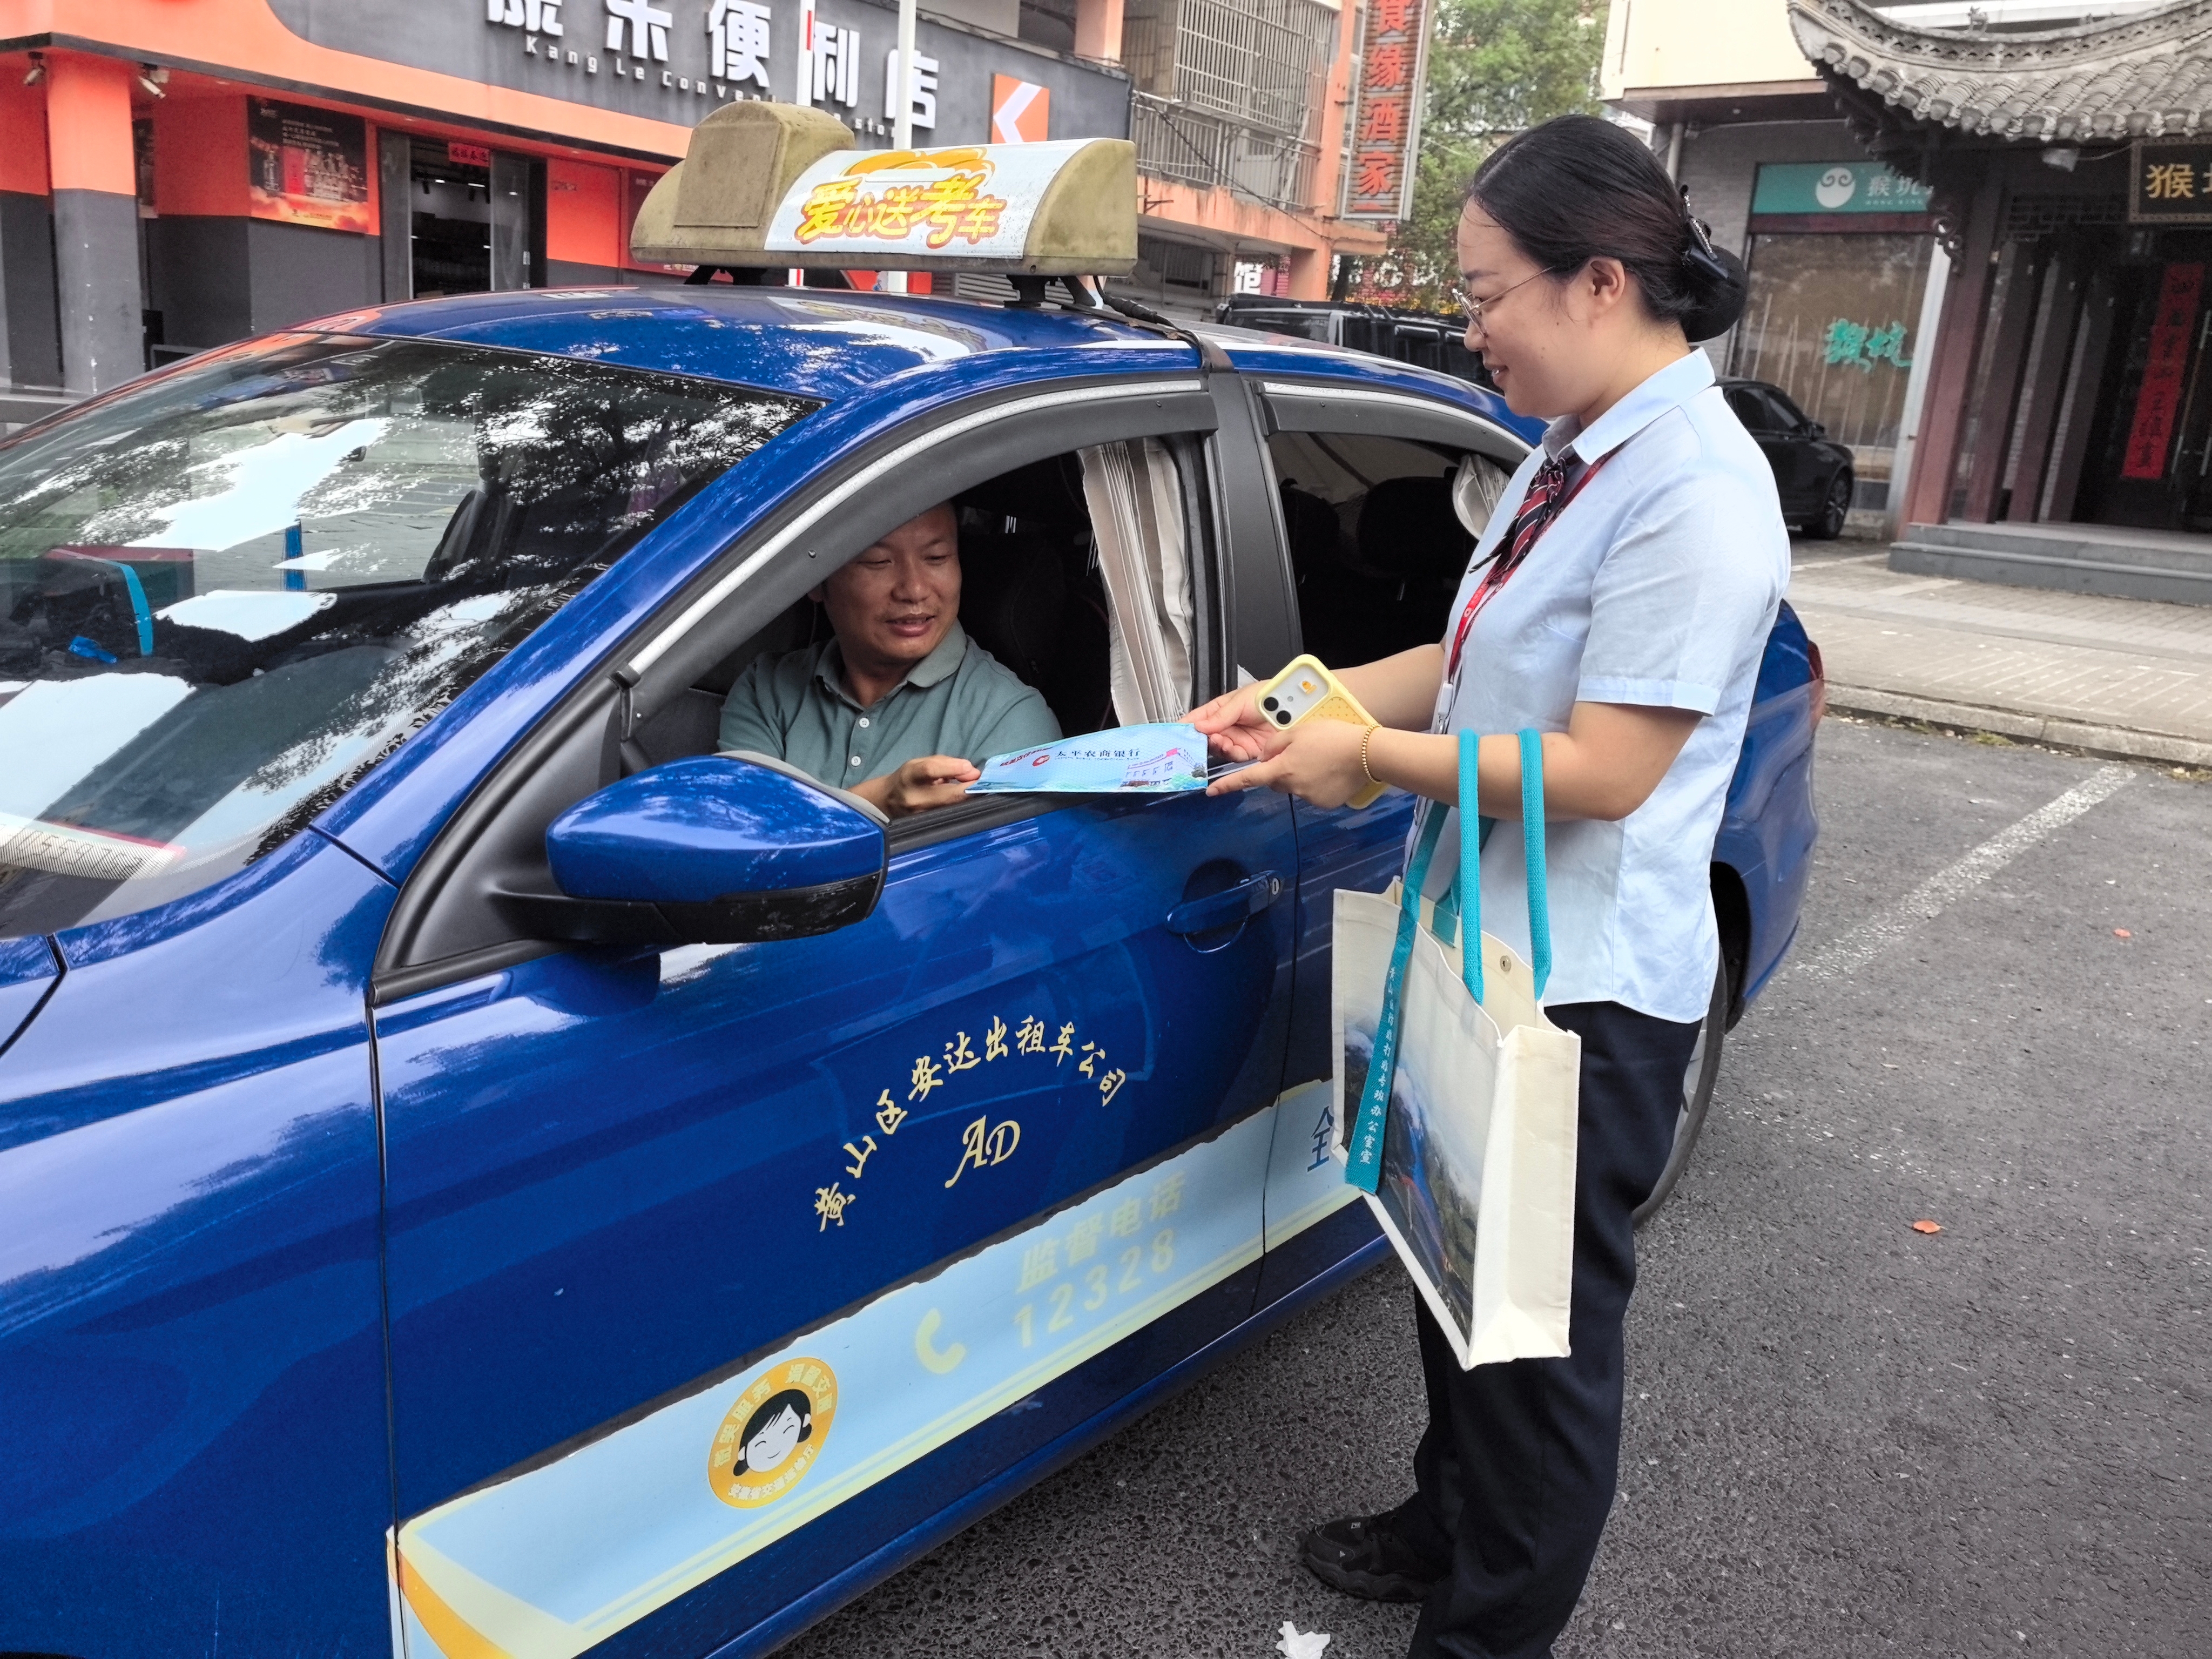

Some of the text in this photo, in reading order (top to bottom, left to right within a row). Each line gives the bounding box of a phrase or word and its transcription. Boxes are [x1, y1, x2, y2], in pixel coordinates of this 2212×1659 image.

[525, 35, 598, 75] Kang
[615, 57, 646, 81] Le
[1353, 0, 1416, 211] 食缘酒家
[796, 174, 1006, 247] 爱心送考车
[814, 1015, 1126, 1232] 黄山区安达出租车公司
[945, 1115, 1021, 1189] AD
[1012, 1229, 1176, 1348] 12328
[1016, 1171, 1185, 1293] 监督电话
